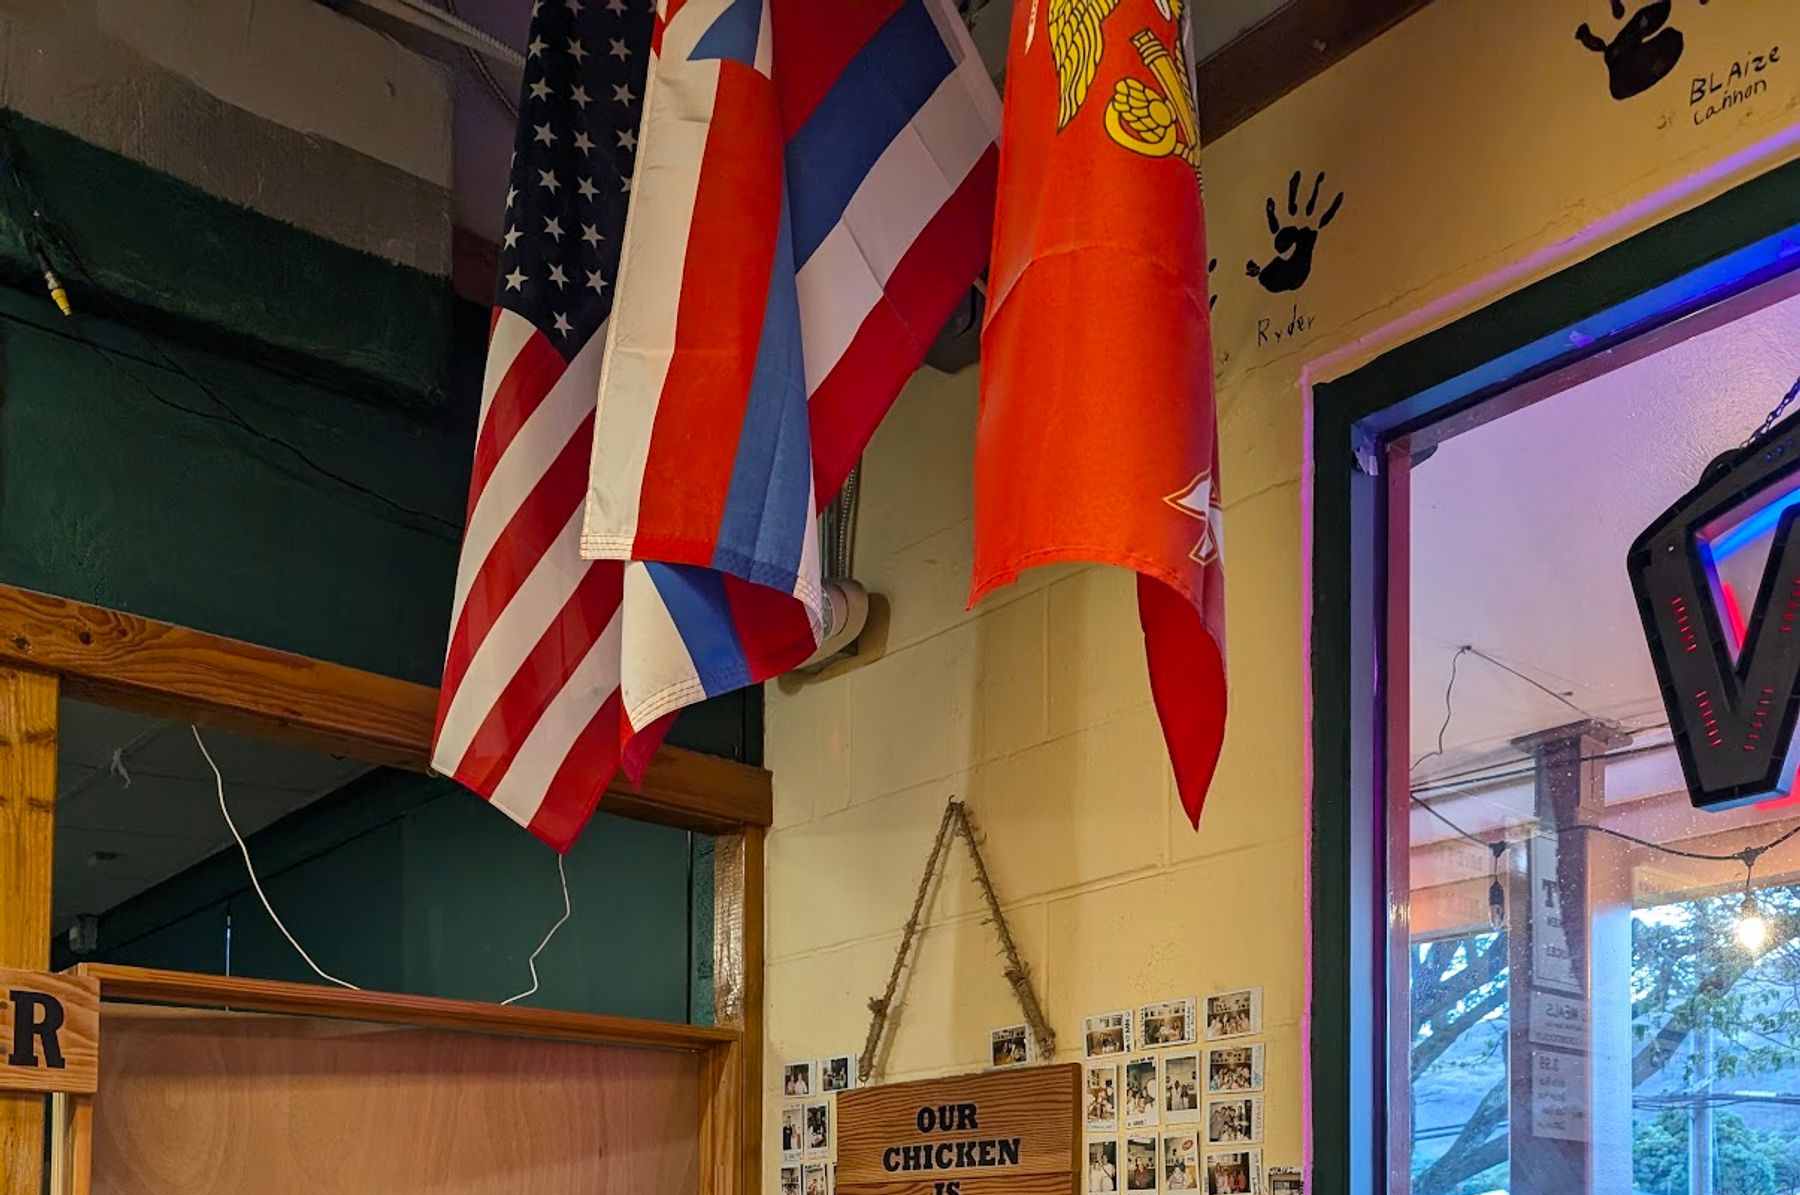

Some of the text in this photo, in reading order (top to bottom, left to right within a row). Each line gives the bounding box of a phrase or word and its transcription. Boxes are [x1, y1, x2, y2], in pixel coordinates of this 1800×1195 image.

[1257, 304, 1316, 348] Ryder
[916, 1103, 979, 1133] OUR
[882, 1138, 1021, 1173] CHICKEN
